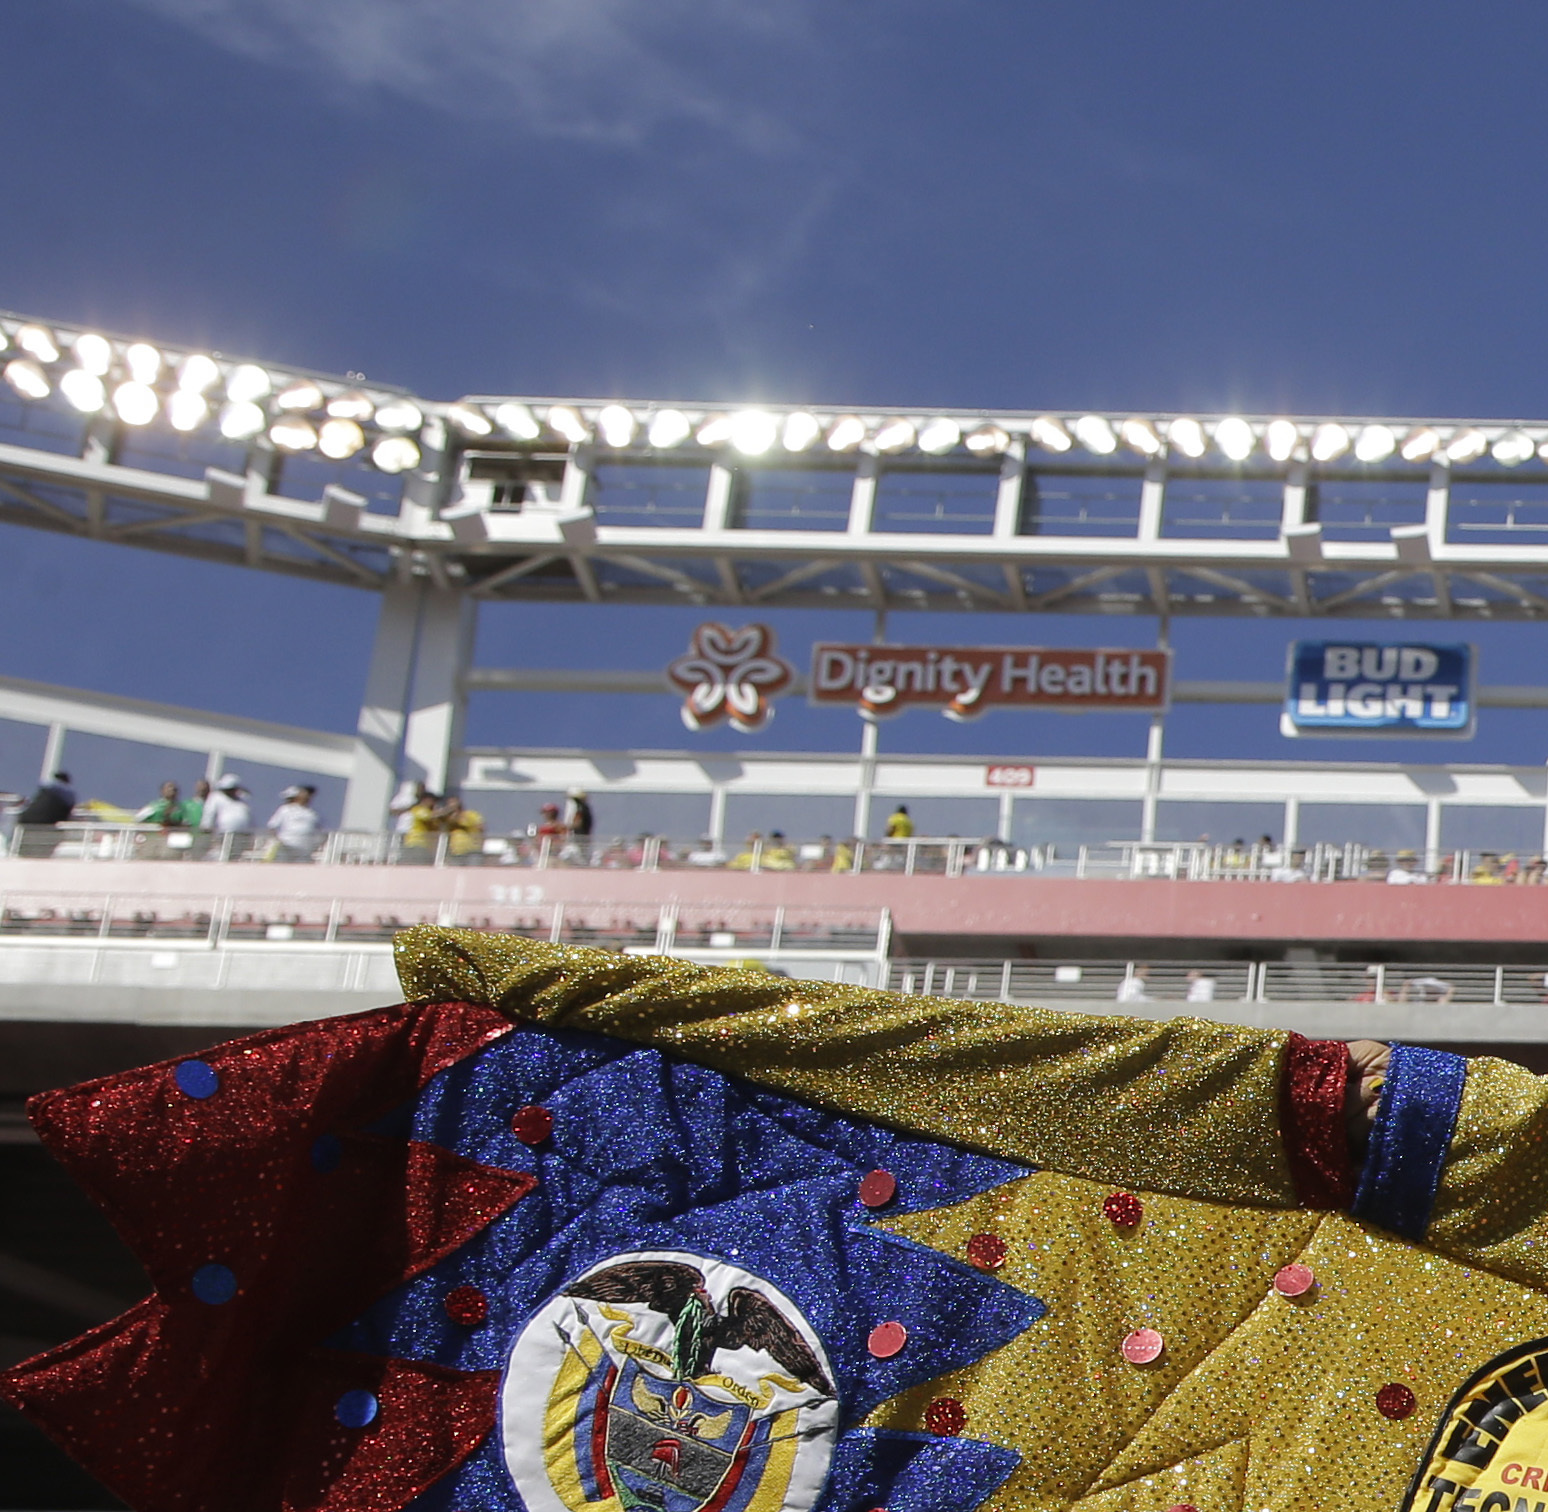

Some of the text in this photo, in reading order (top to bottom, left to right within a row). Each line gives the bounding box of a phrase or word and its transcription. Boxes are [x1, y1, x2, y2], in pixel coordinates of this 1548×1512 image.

[818, 650, 1158, 704] Dignity Health
[1323, 646, 1439, 681] BUD
[1297, 682, 1459, 719] LIGHT
[722, 1376, 760, 1408] Orden
